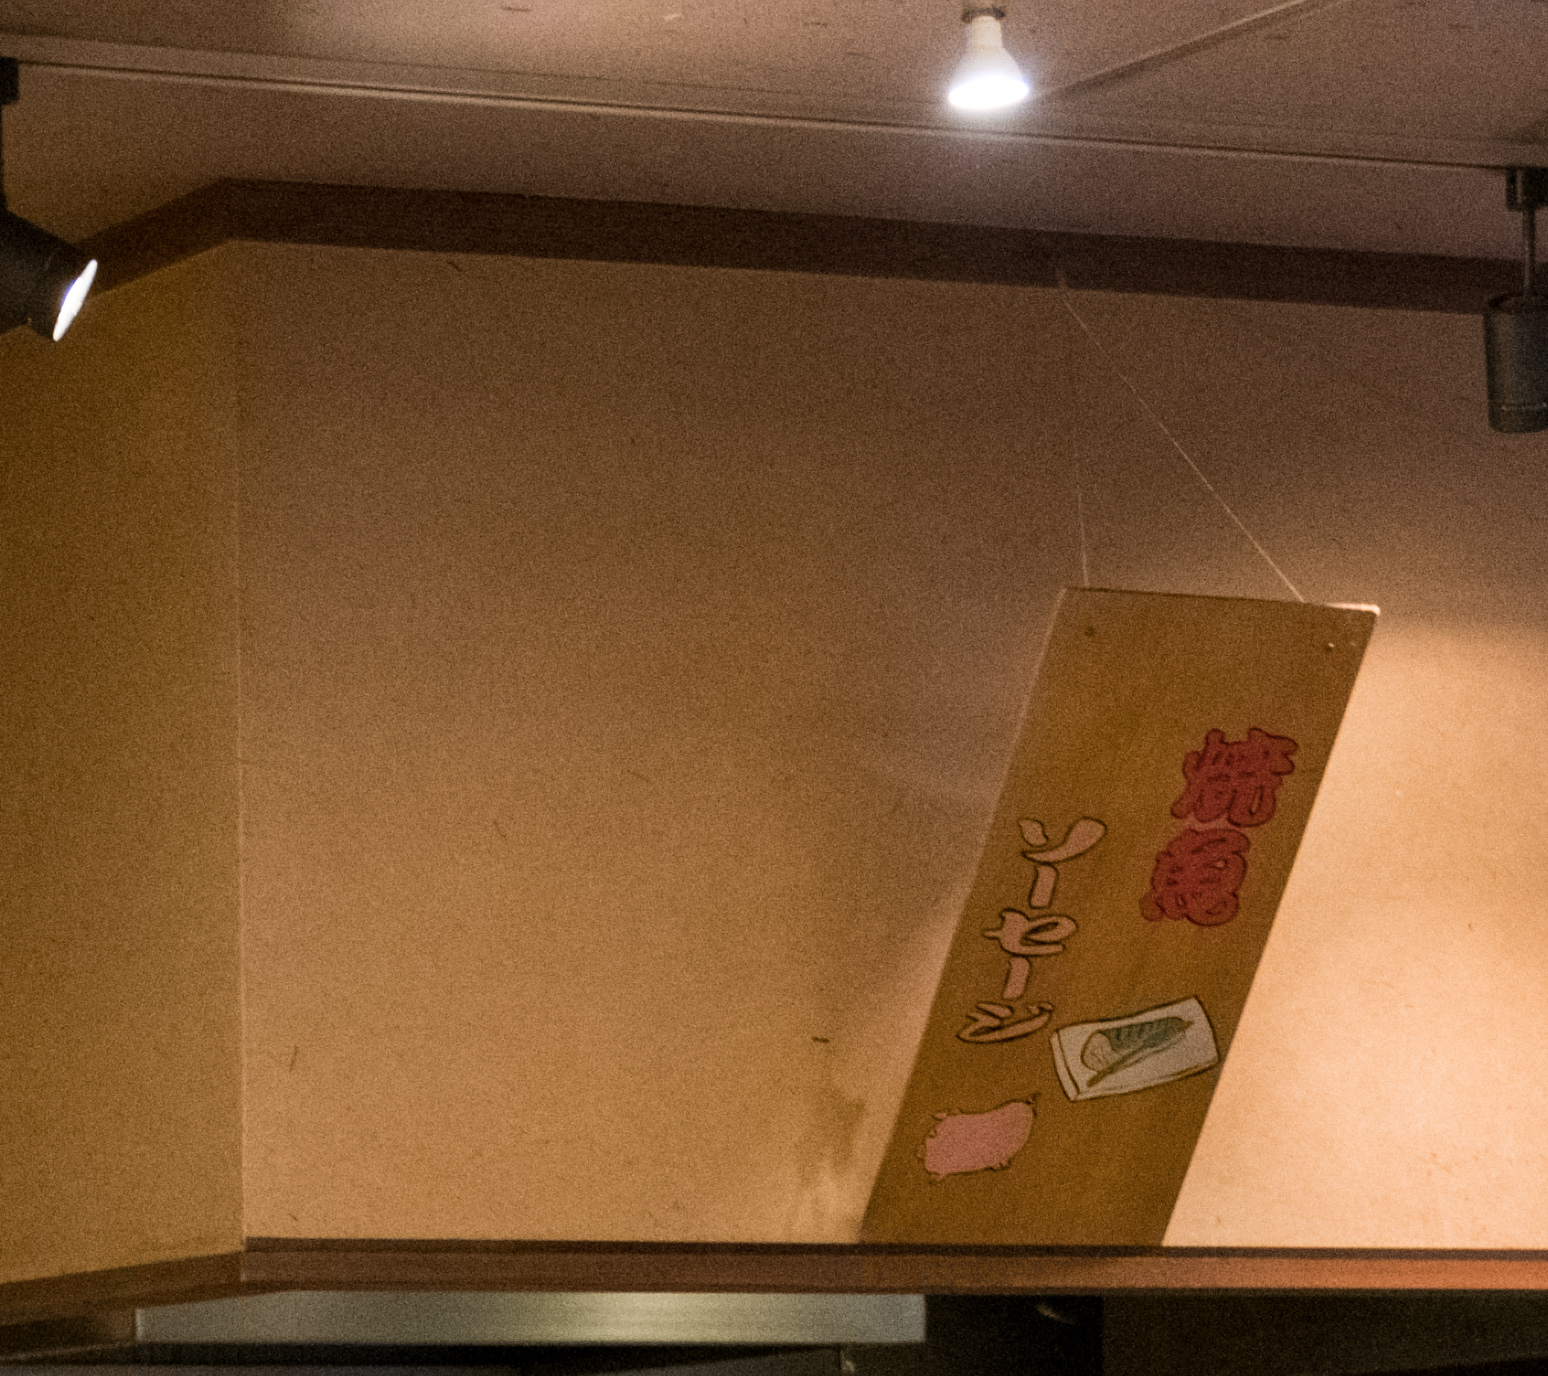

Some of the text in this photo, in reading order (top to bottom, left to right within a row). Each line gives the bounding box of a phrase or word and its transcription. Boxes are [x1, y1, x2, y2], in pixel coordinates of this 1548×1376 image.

[956, 815, 1107, 1043] ソーセージ
